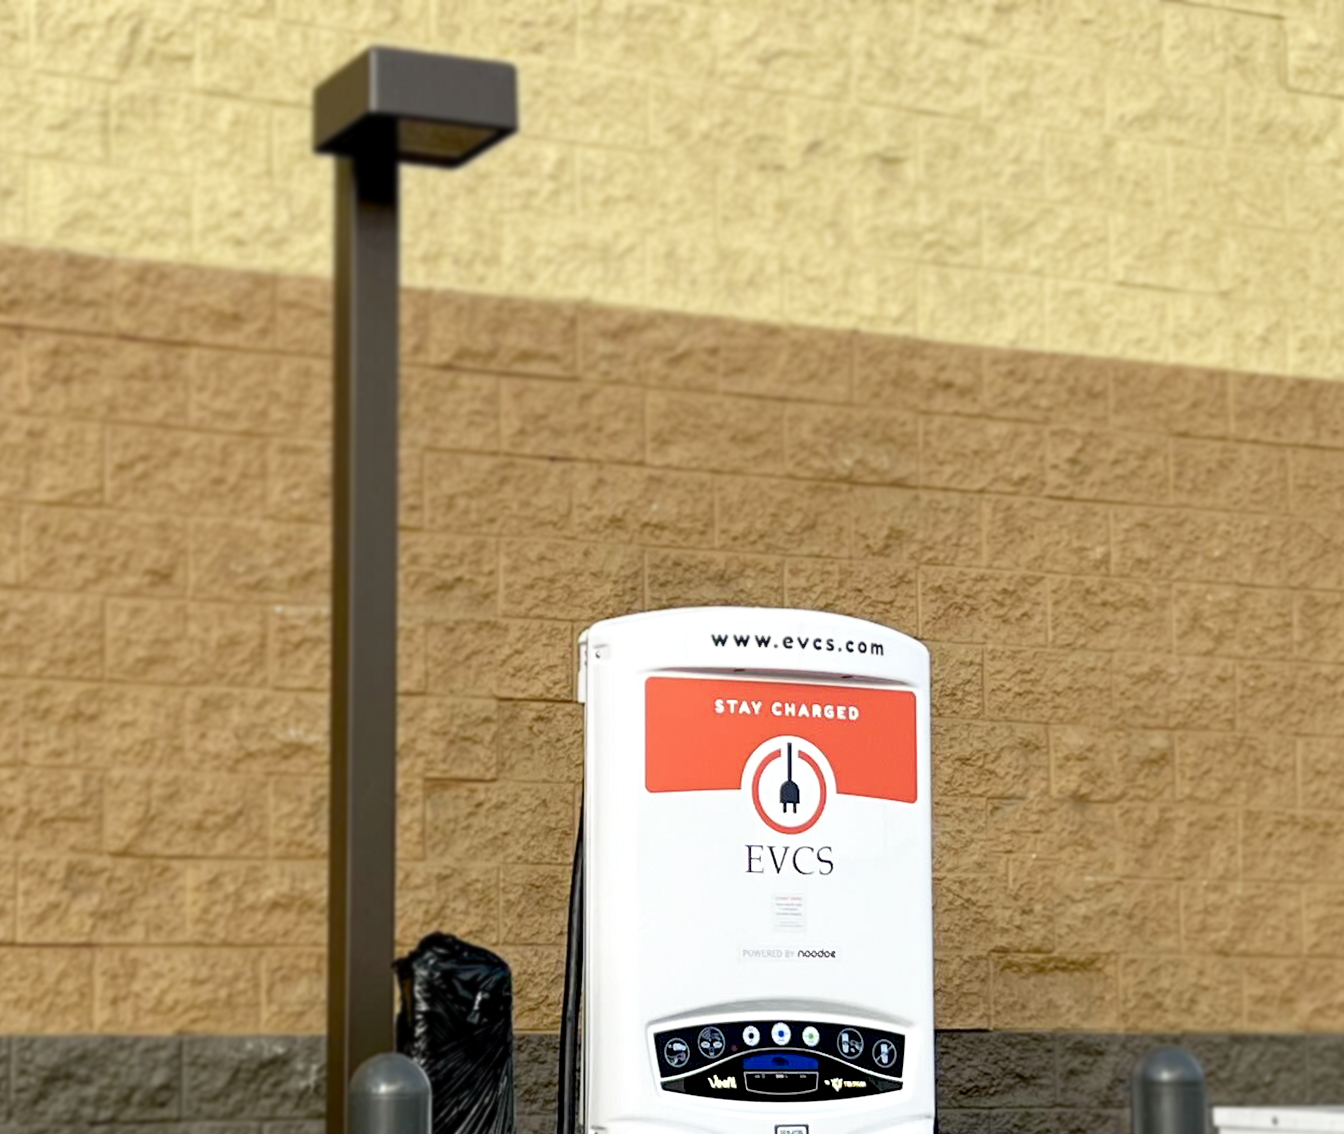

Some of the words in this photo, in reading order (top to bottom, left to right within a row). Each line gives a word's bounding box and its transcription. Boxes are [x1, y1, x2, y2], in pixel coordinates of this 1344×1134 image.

[711, 634, 884, 656] www.evcs.com
[714, 699, 762, 715] STAY
[771, 701, 860, 720] CHARGED
[745, 844, 834, 876] EVCS
